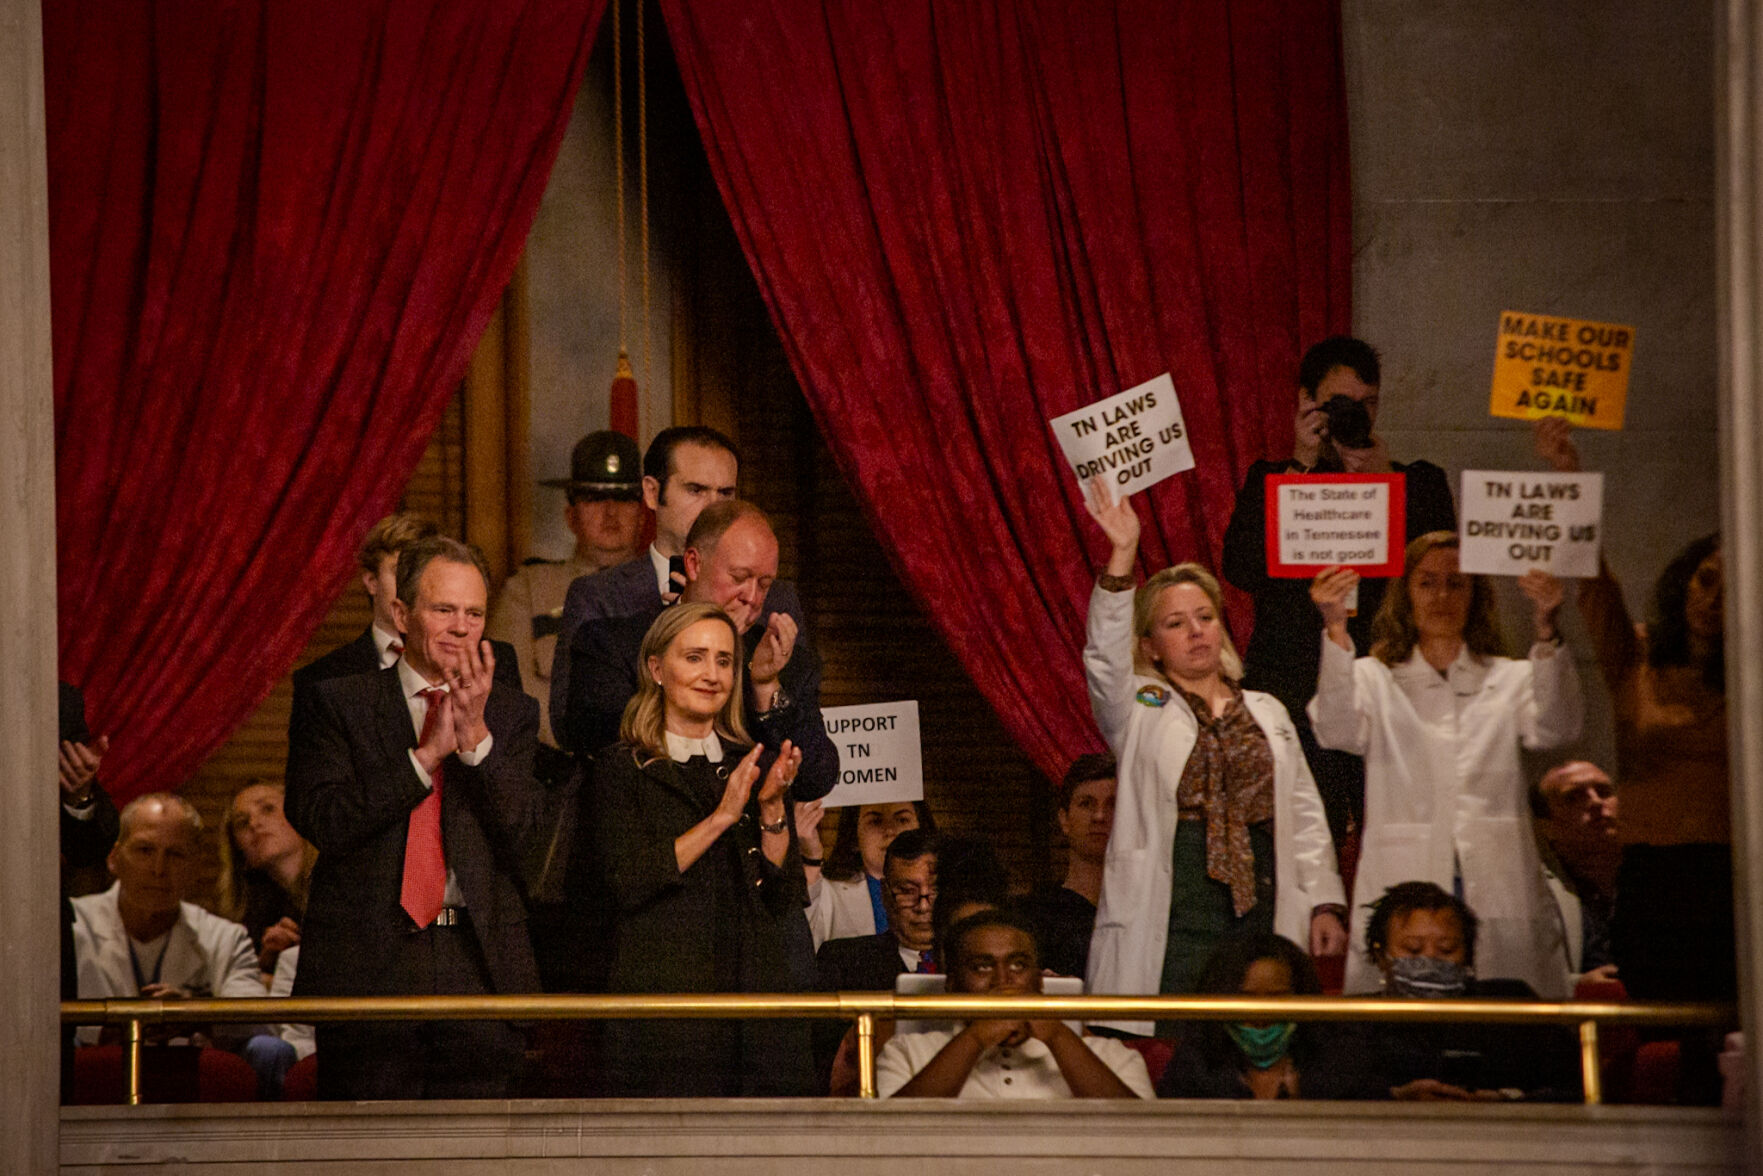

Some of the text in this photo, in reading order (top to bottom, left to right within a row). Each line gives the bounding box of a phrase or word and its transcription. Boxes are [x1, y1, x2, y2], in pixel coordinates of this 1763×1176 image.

[1504, 316, 1629, 348] MAKE OUR
[1505, 341, 1620, 371] SCHOOLS
[1532, 367, 1587, 391] SAFE
[1516, 390, 1597, 415] AGAIN
[1071, 392, 1157, 438] TN LAWS
[1105, 421, 1141, 449] ARE
[1076, 423, 1183, 480] DRIVING US
[1117, 458, 1152, 485] OUT
[1290, 487, 1377, 500] The State of
[1485, 481, 1580, 500] TN LAWS
[1293, 509, 1372, 520] Healthcare
[1511, 503, 1553, 520] ARE
[1286, 529, 1381, 540] in Tennessee
[1467, 520, 1596, 542] DRIVING US
[1293, 548, 1375, 562] is not good
[1509, 543, 1553, 561] OUT
[827, 715, 897, 734] UPPORT
[846, 743, 870, 758] TN
[836, 767, 897, 785] OMEN
